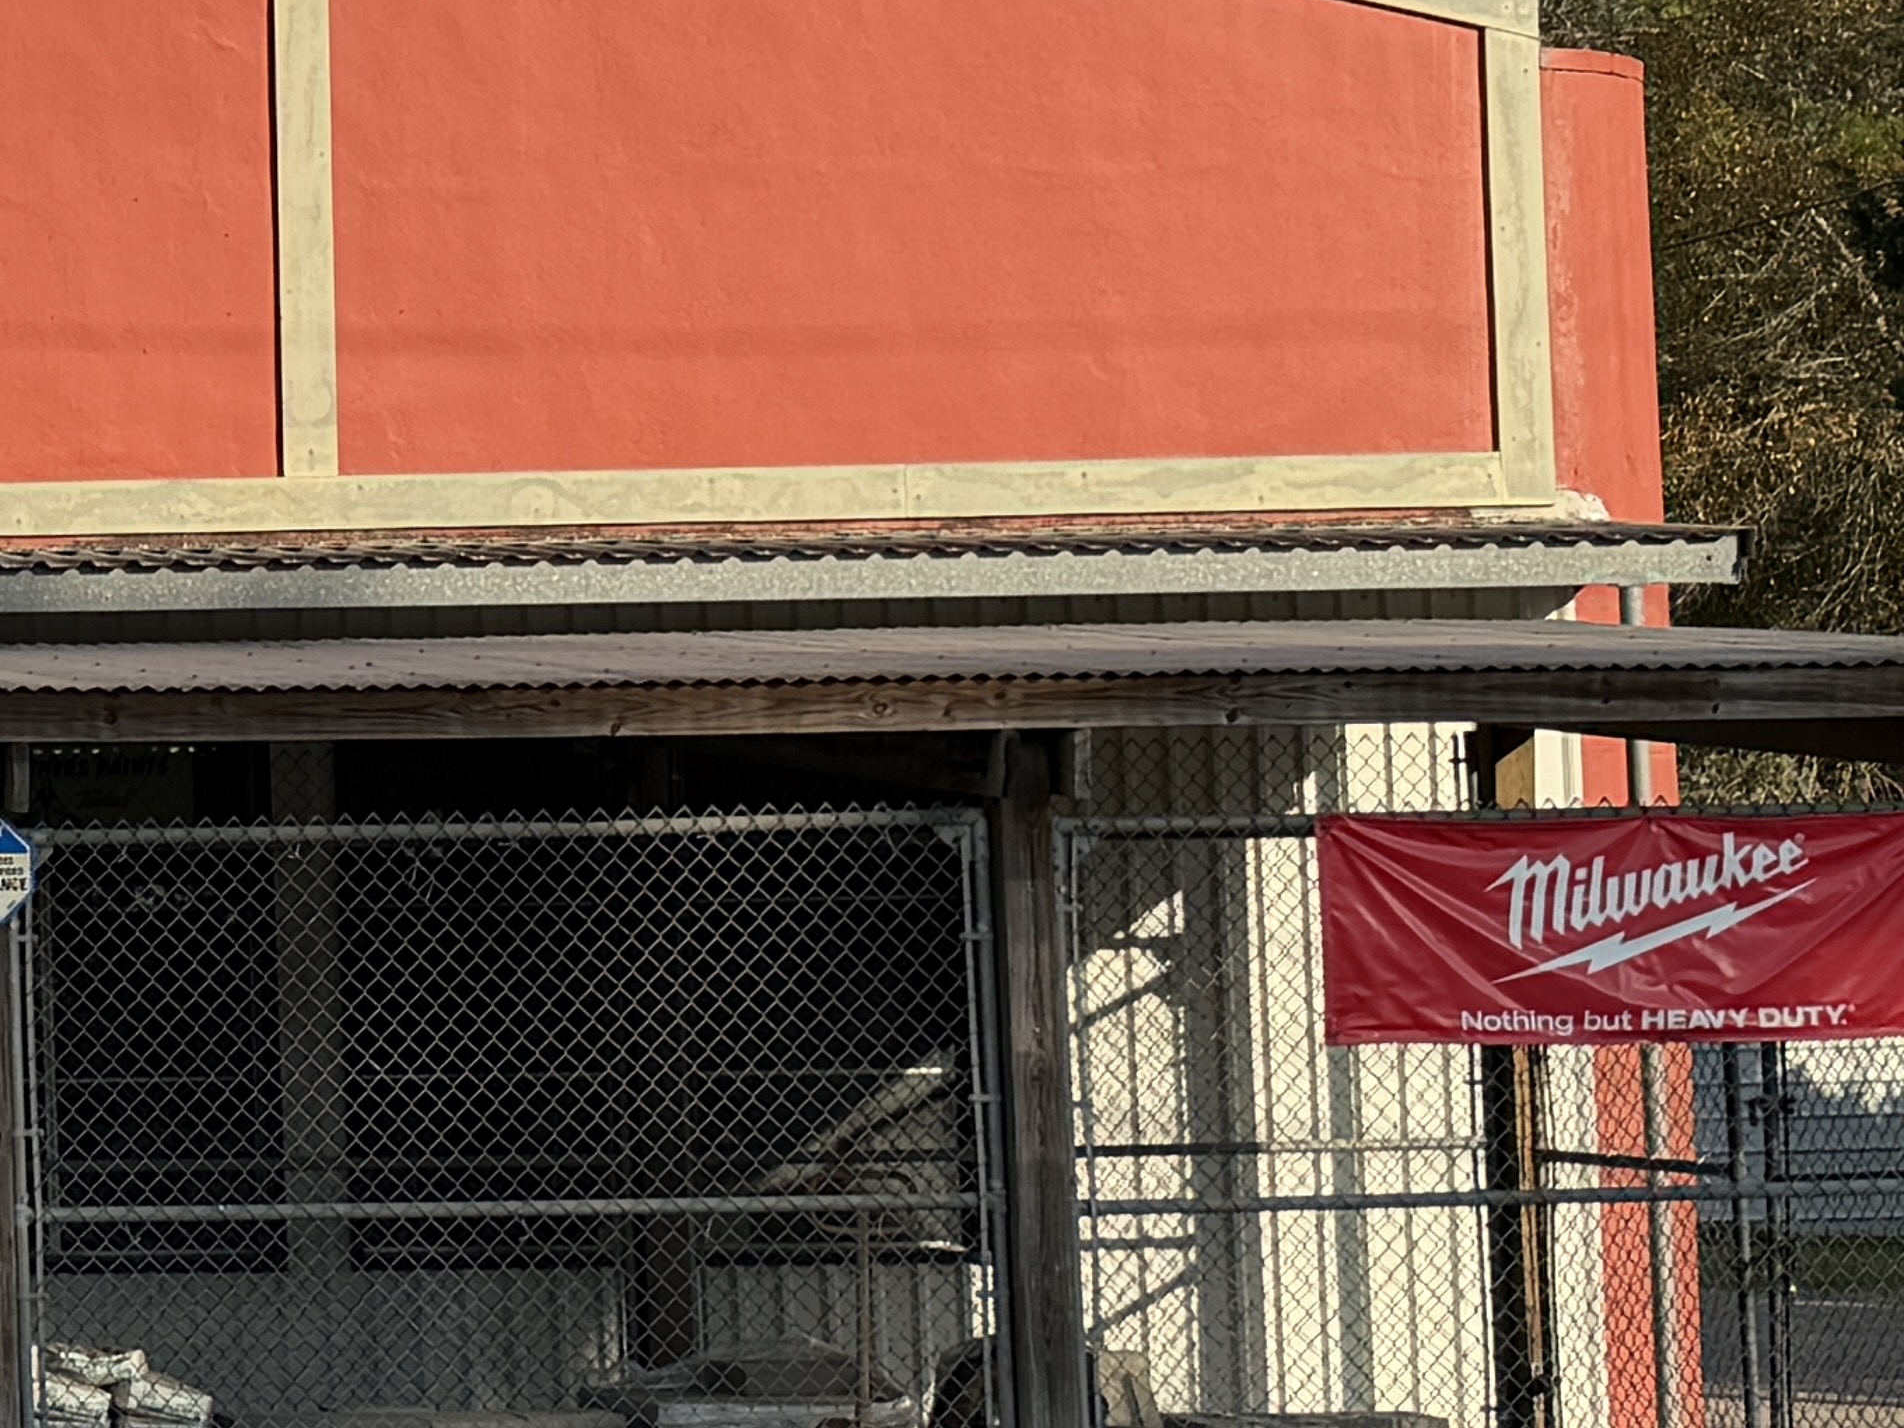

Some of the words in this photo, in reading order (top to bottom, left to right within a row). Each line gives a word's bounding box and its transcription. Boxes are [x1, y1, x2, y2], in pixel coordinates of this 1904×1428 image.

[1485, 832, 1810, 950] Milwaukee
[1461, 1009, 1574, 1037] Nothing
[1583, 1008, 1632, 1032] but
[1641, 1007, 1750, 1031] HEAVY
